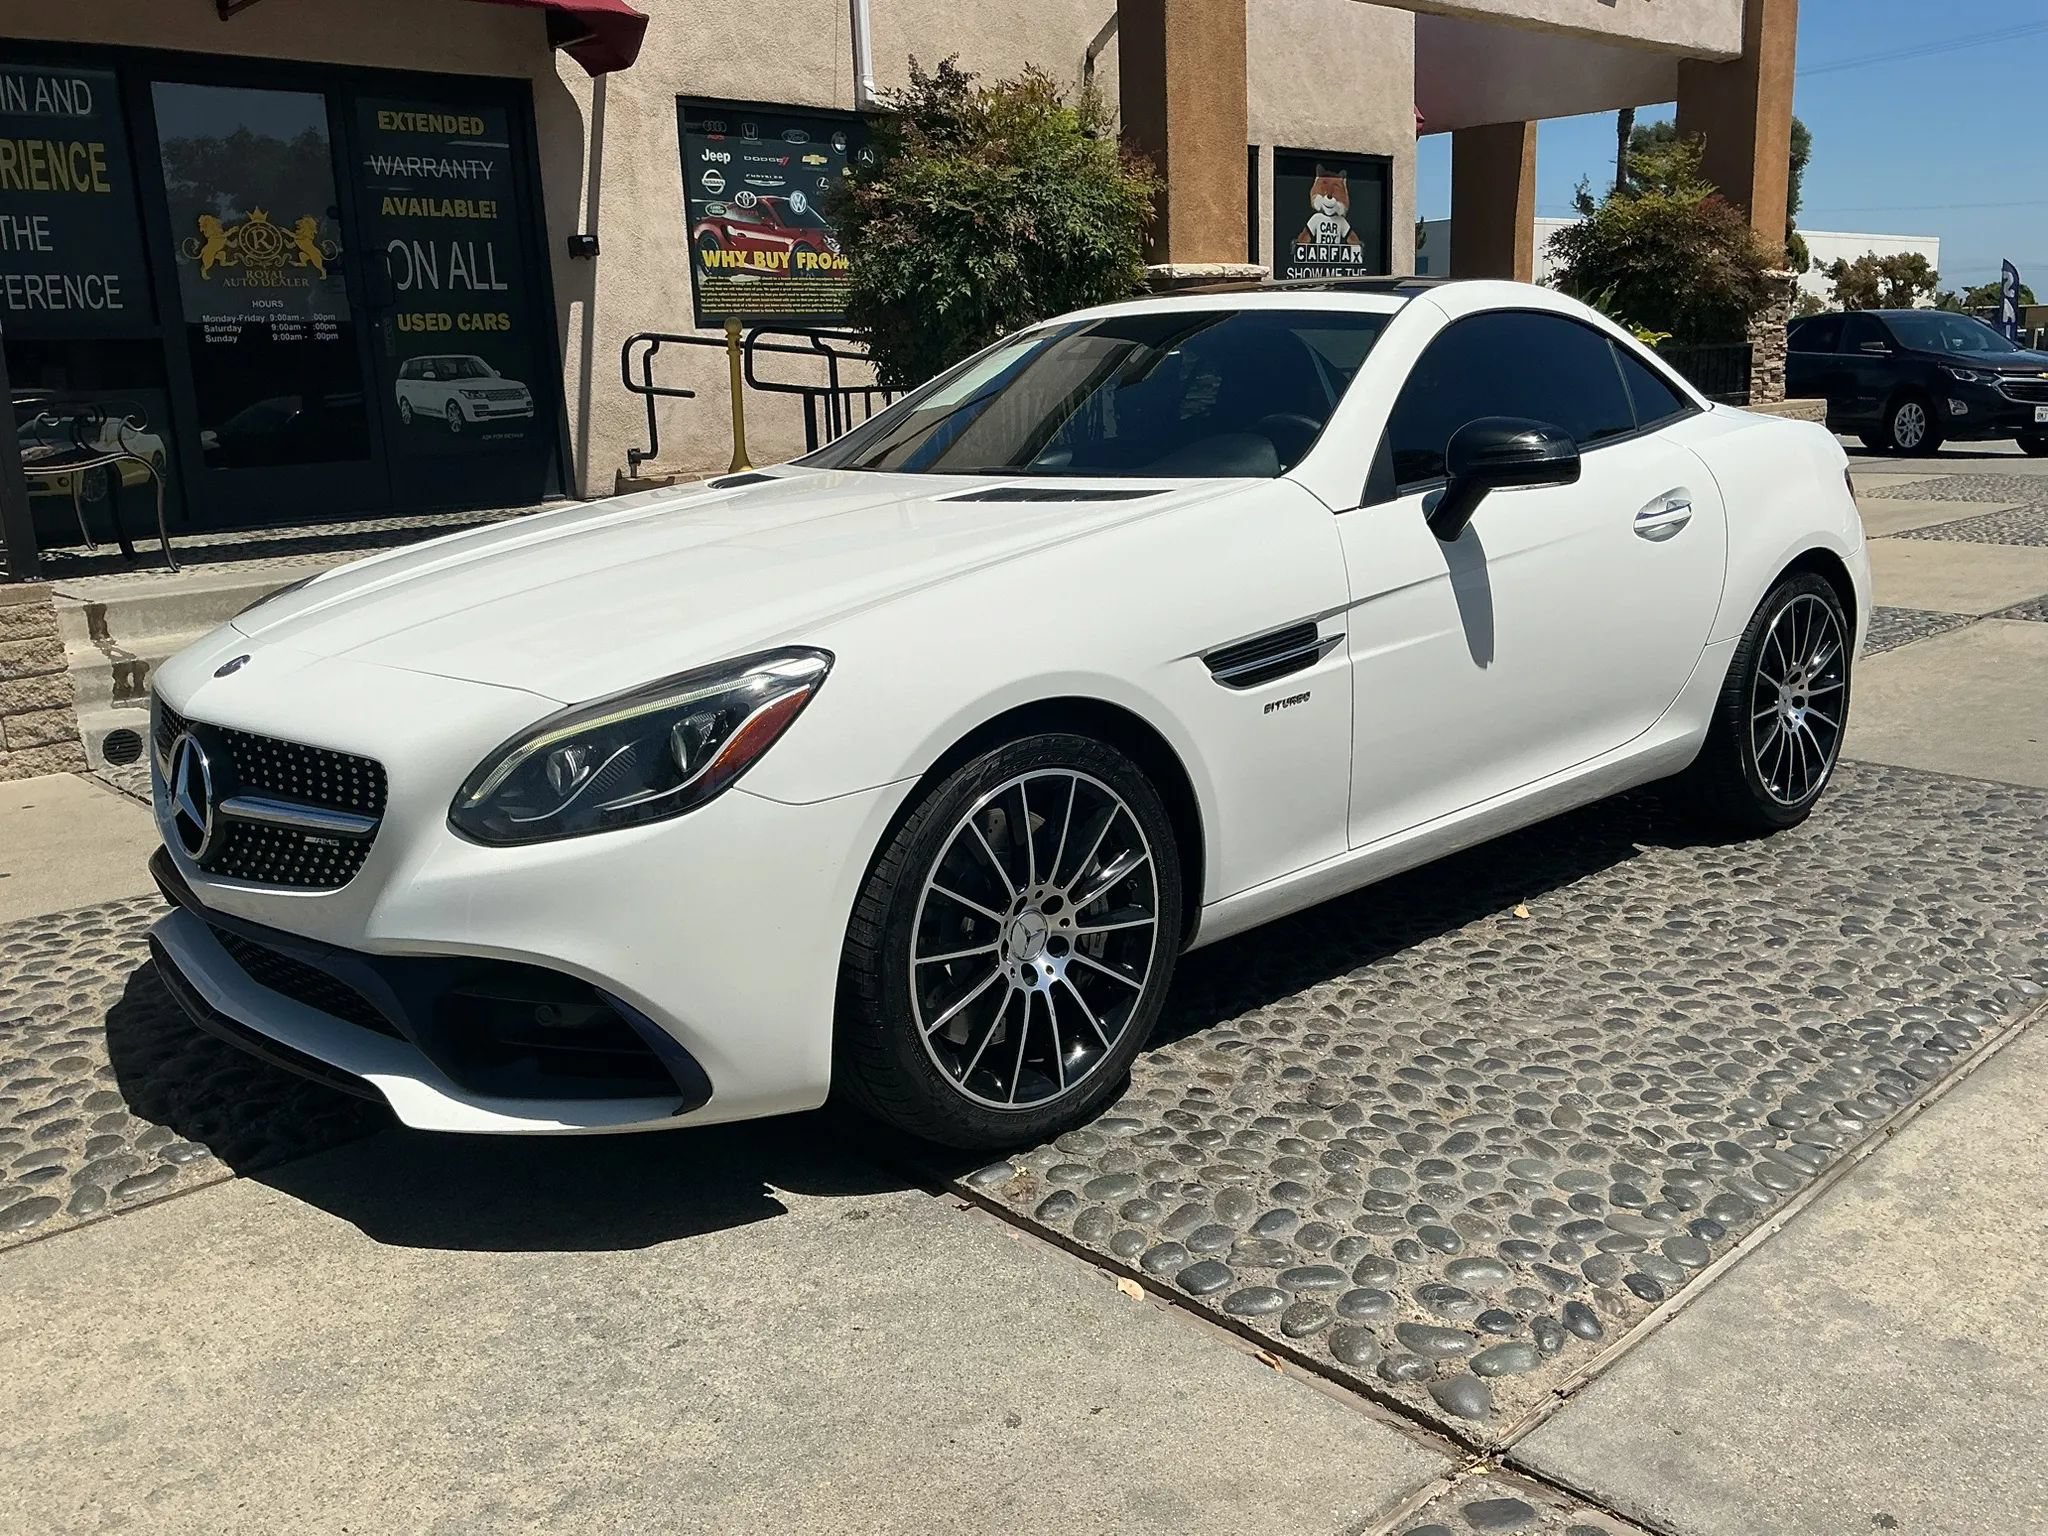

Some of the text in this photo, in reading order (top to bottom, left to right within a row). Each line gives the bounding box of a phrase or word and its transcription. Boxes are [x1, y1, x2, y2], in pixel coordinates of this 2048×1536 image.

[35, 77, 92, 115] AND
[377, 110, 485, 136] EXTENDED
[701, 148, 731, 165] Jeep
[743, 155, 784, 163] DODGE
[370, 154, 494, 181] WARRANTY
[381, 196, 497, 219] AVAILABLE!
[0, 215, 53, 251] THE
[1320, 222, 1338, 234] CAR
[1320, 234, 1338, 244] FOX
[702, 250, 748, 268] WHY
[753, 251, 792, 269] BUY
[1296, 246, 1361, 263] CARFAX
[387, 239, 508, 291] ON ALL
[222, 277, 310, 288] AUTO DEALER
[245, 269, 287, 280] ROYAL
[0, 274, 124, 310] FERENCE
[252, 300, 284, 309] HOURS
[202, 314, 266, 324] Monday-Friday
[269, 313, 300, 322] 9:00am
[398, 312, 511, 332] USED CARS
[204, 324, 243, 334] Saturday
[271, 323, 301, 332] 9:00am
[205, 334, 238, 344] Sunday
[272, 332, 303, 341] 9:00am
[315, 838, 339, 846] AMG
